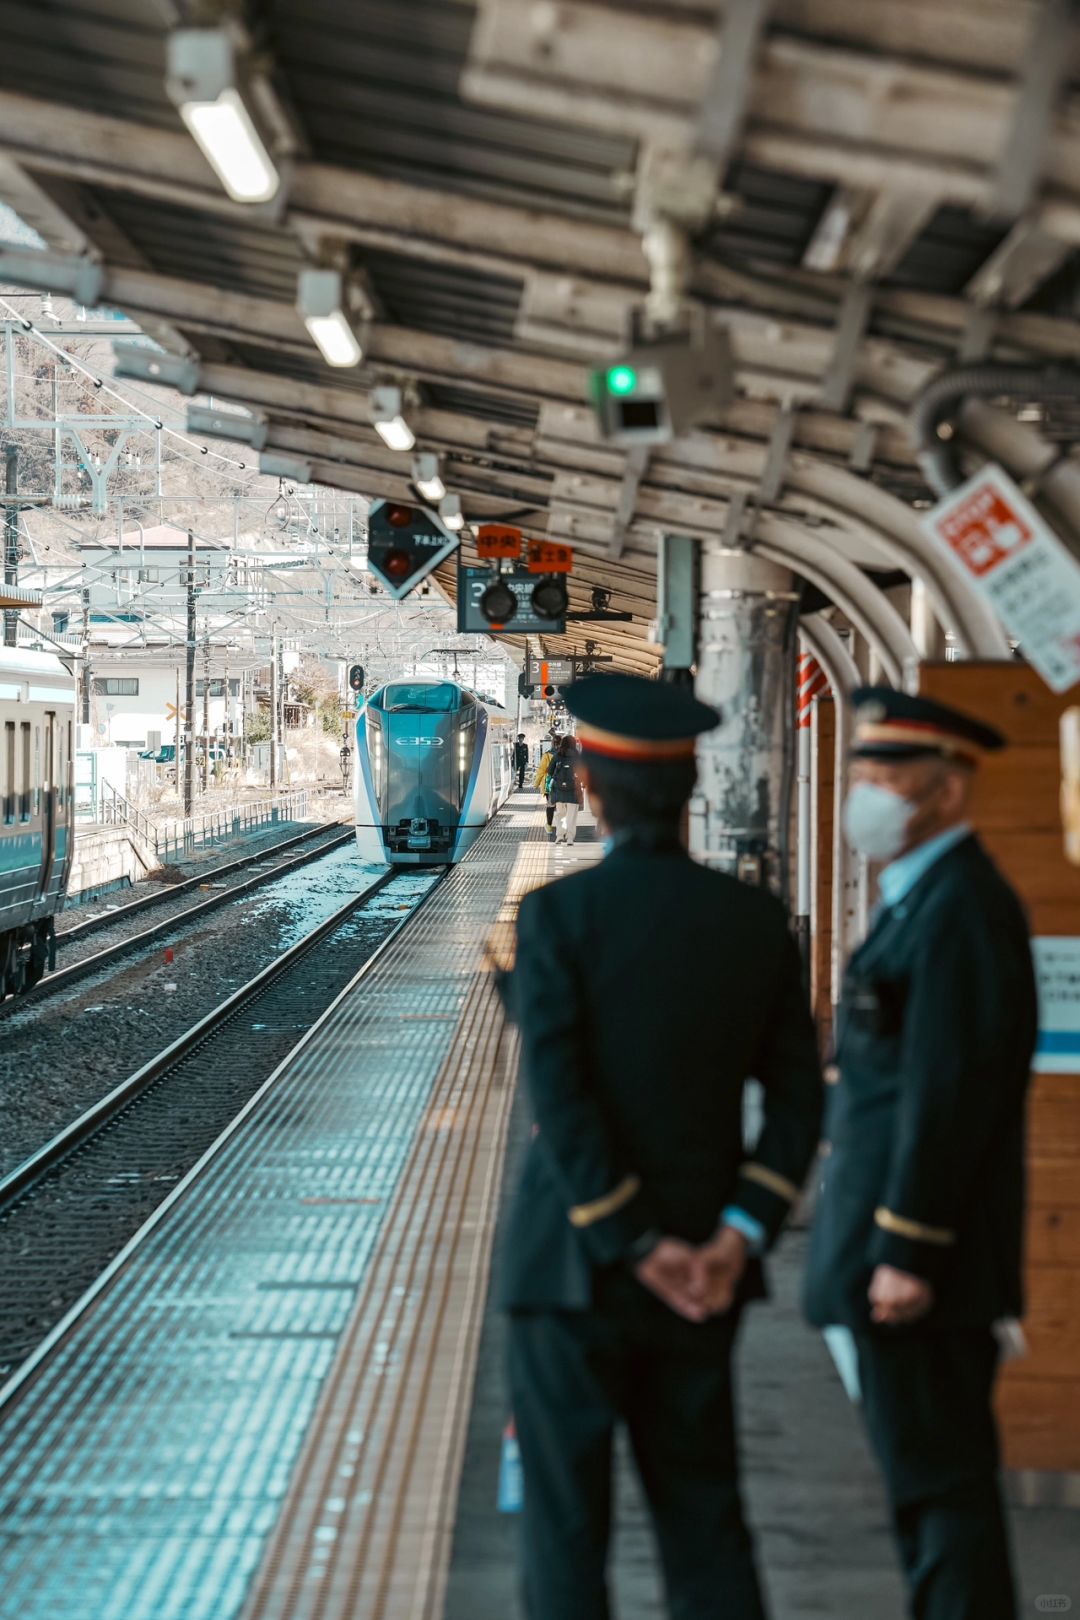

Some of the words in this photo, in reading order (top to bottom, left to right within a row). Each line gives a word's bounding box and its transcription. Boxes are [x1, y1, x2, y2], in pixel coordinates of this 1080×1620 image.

[481, 535, 515, 547] 中央
[532, 661, 540, 674] 3
[195, 757, 204, 766] 52
